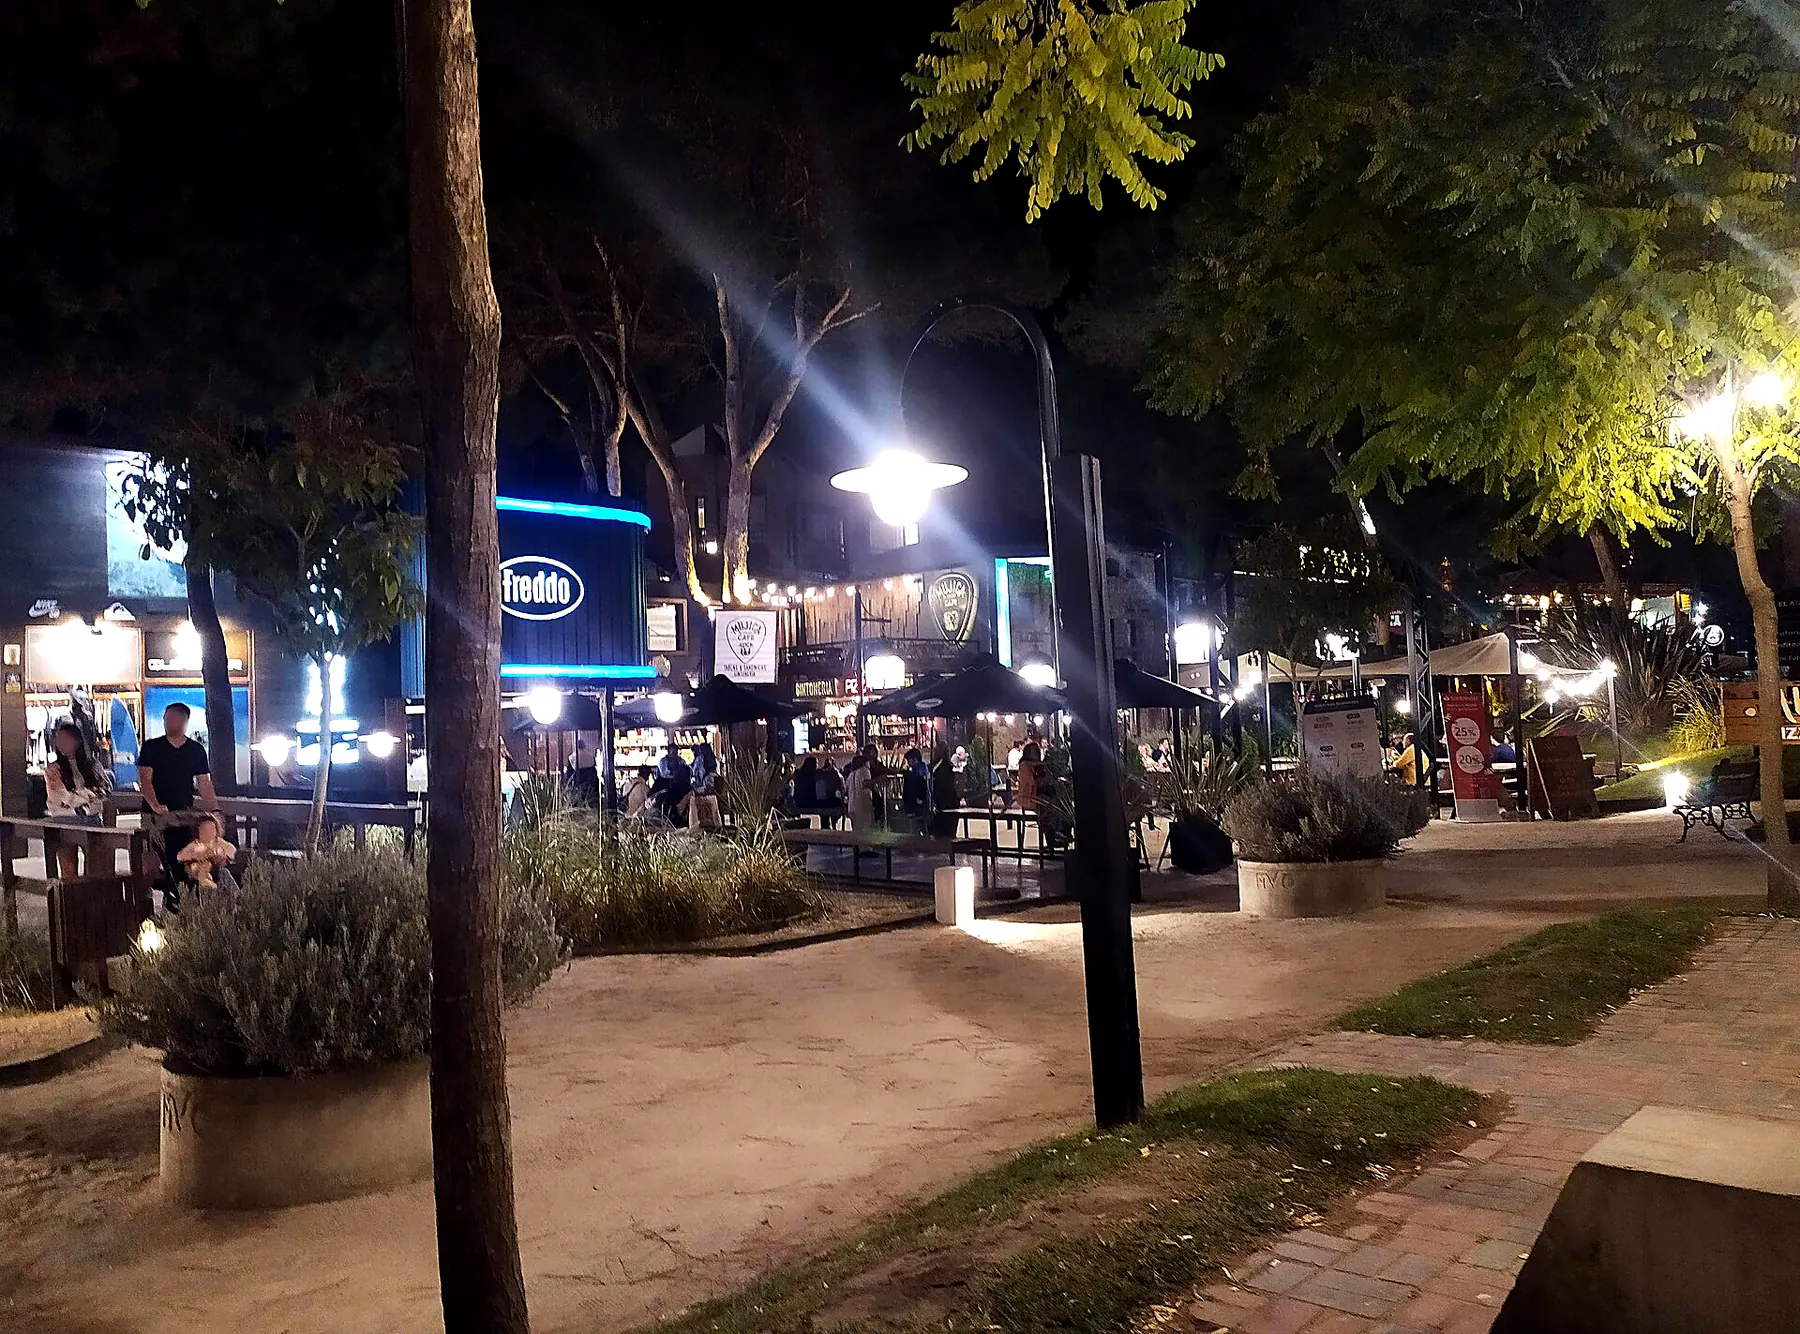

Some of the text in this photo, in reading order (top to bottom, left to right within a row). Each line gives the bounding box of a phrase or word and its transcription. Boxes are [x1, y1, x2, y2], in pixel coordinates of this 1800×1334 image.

[502, 568, 571, 606] freddo
[935, 580, 967, 600] MUJICA
[731, 620, 762, 636] MUJICA
[1455, 727, 1477, 738] 25%
[1459, 754, 1481, 765] 20%
